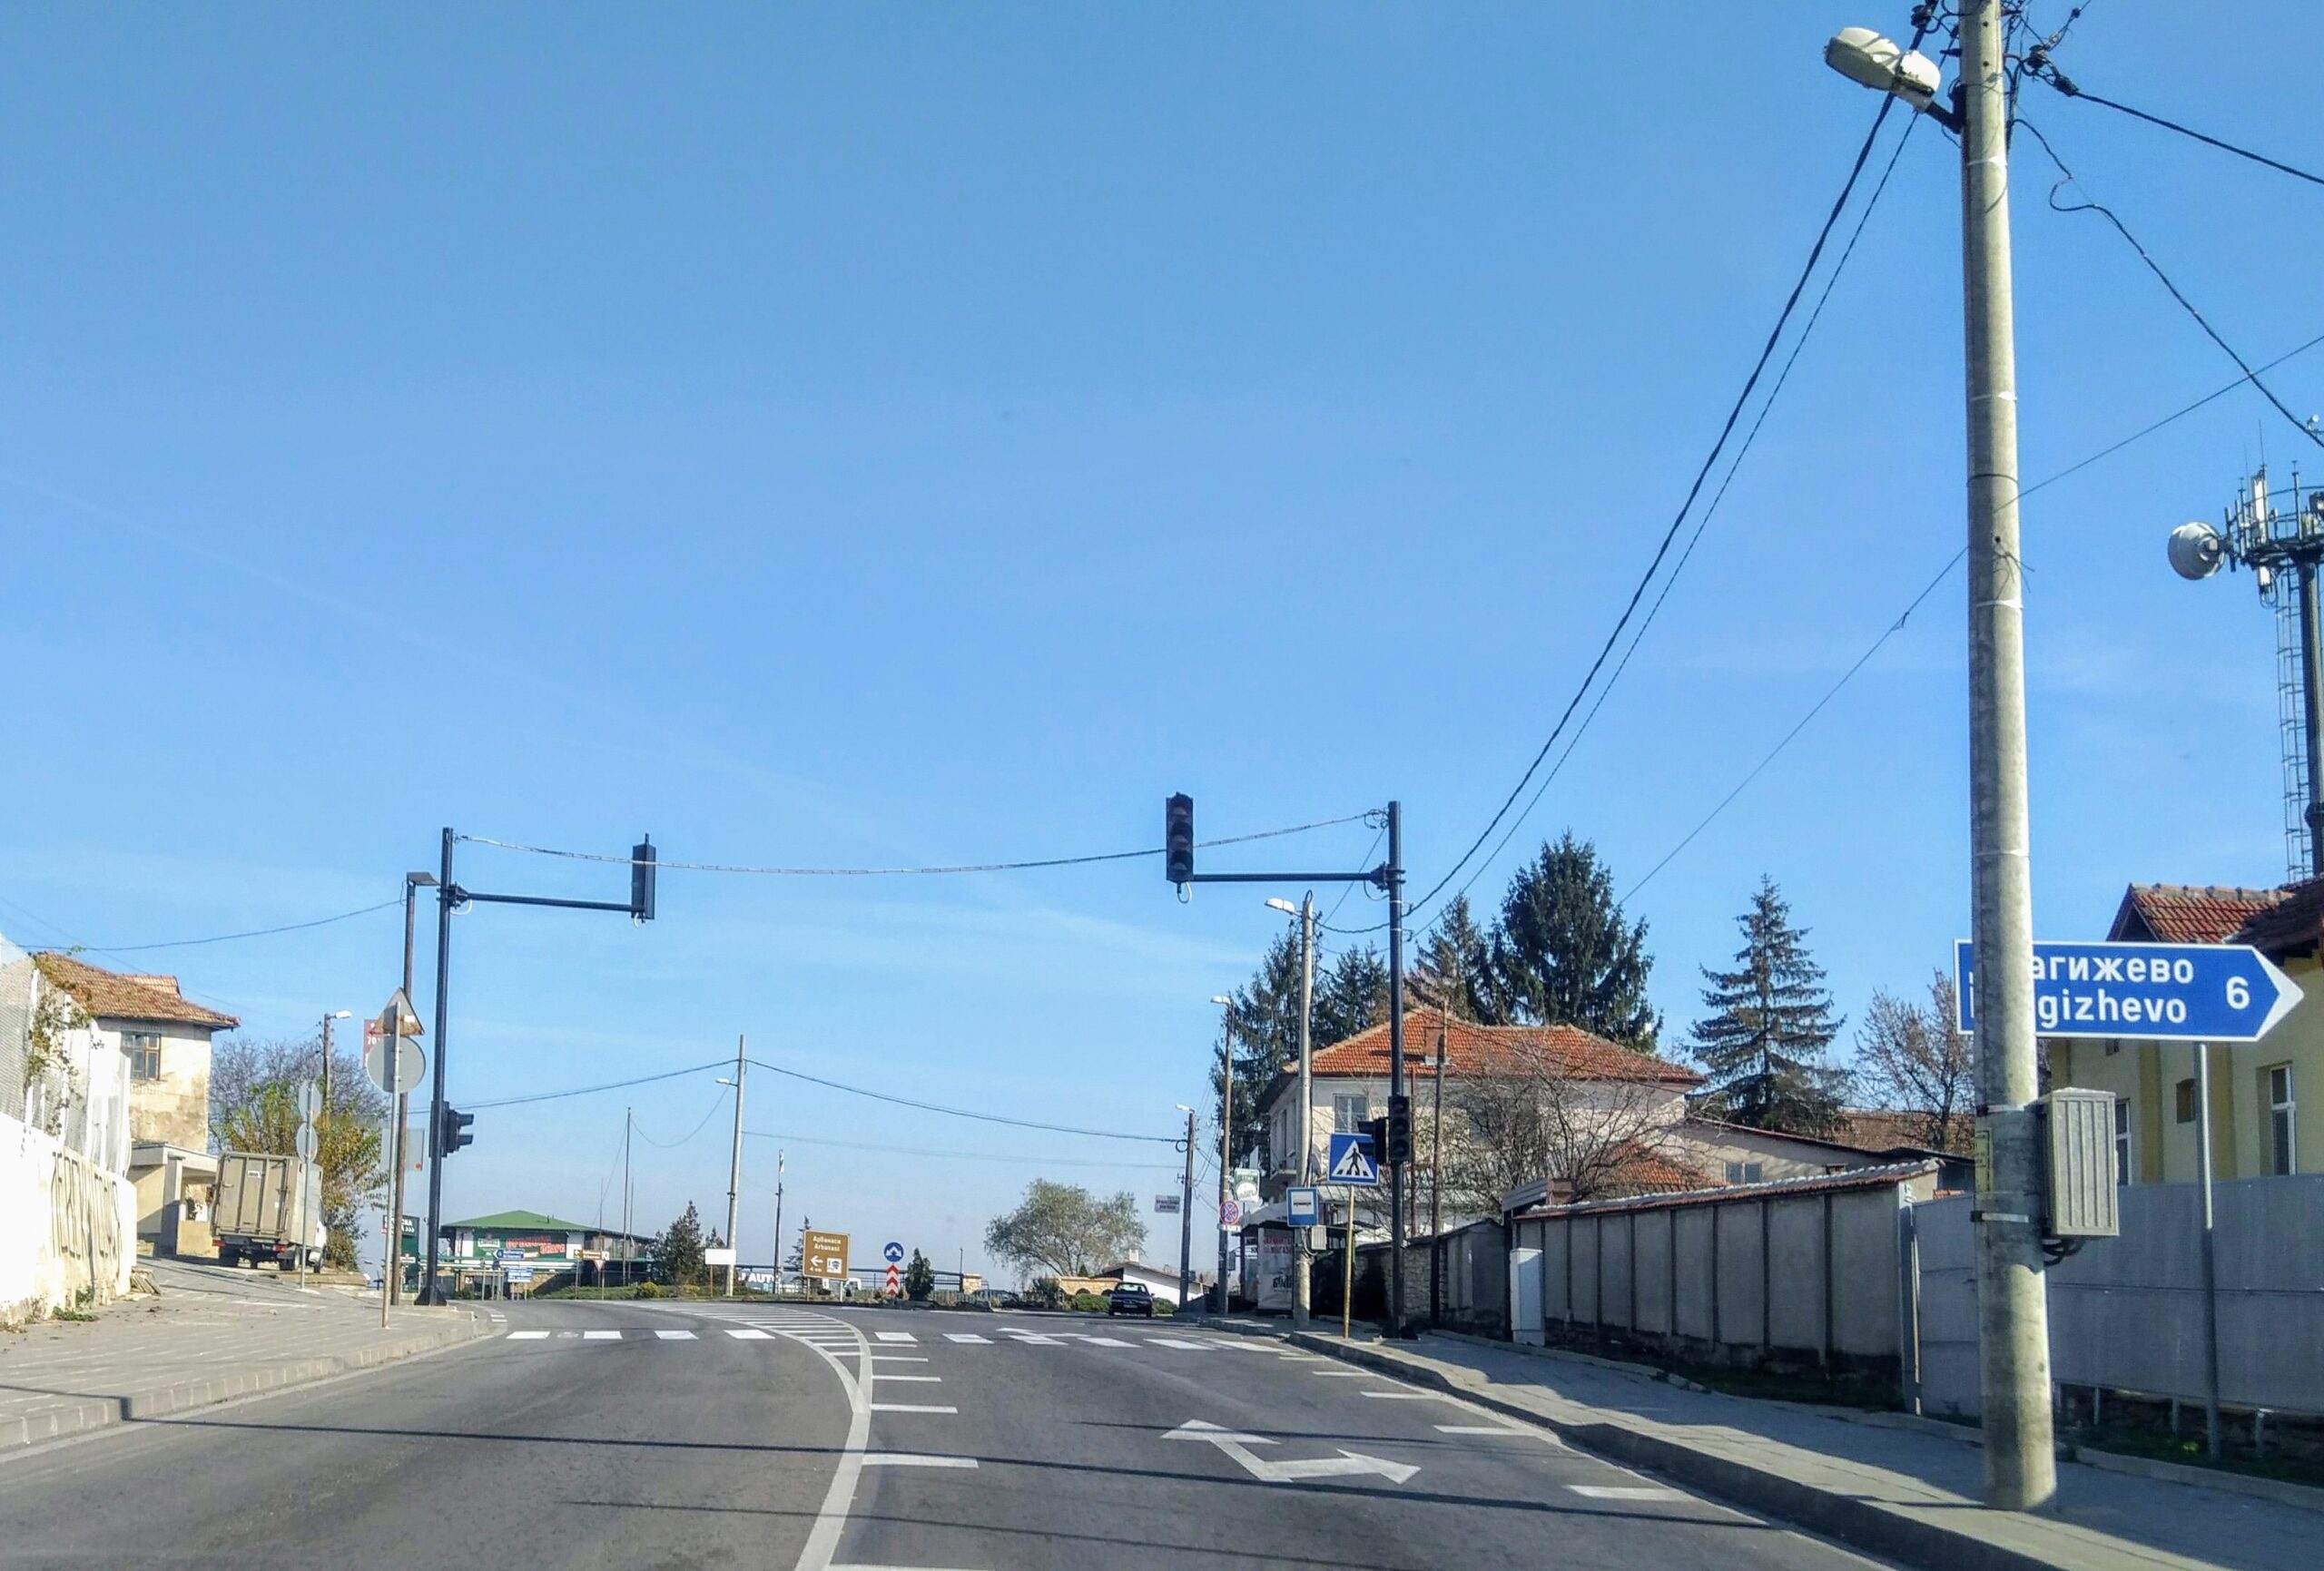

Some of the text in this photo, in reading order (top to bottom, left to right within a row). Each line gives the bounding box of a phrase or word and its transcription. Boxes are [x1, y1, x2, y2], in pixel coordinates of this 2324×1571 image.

[1969, 956, 2193, 984] агижево
[1970, 987, 2187, 1028] gizhevo
[2226, 976, 2250, 1010] 6
